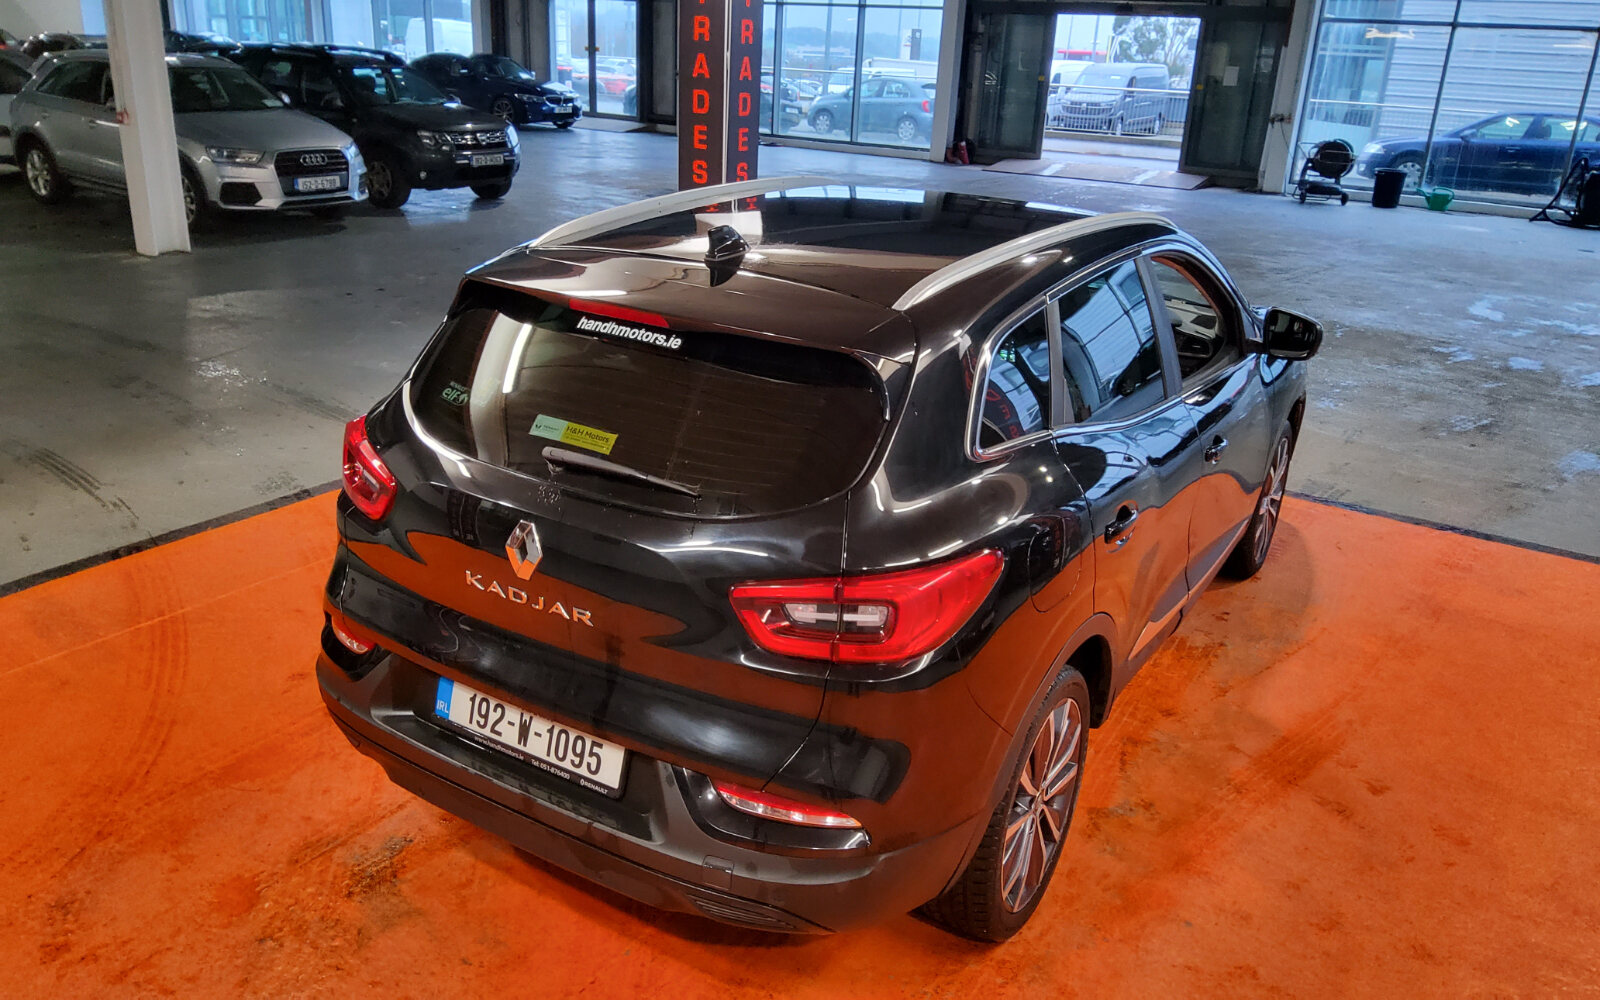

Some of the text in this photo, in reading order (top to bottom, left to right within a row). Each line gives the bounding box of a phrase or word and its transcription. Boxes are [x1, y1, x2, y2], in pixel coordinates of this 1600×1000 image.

[692, 0, 711, 184] RADES
[736, 0, 754, 182] RADES
[577, 316, 682, 349] handhmotors.ie
[442, 387, 462, 401] elf
[566, 425, 585, 436] H&H
[585, 431, 611, 443] Motors
[465, 570, 594, 627] KADJAR
[436, 699, 449, 714] IRL
[469, 693, 604, 776] 192-W-1095
[584, 780, 609, 796] RENAULT
